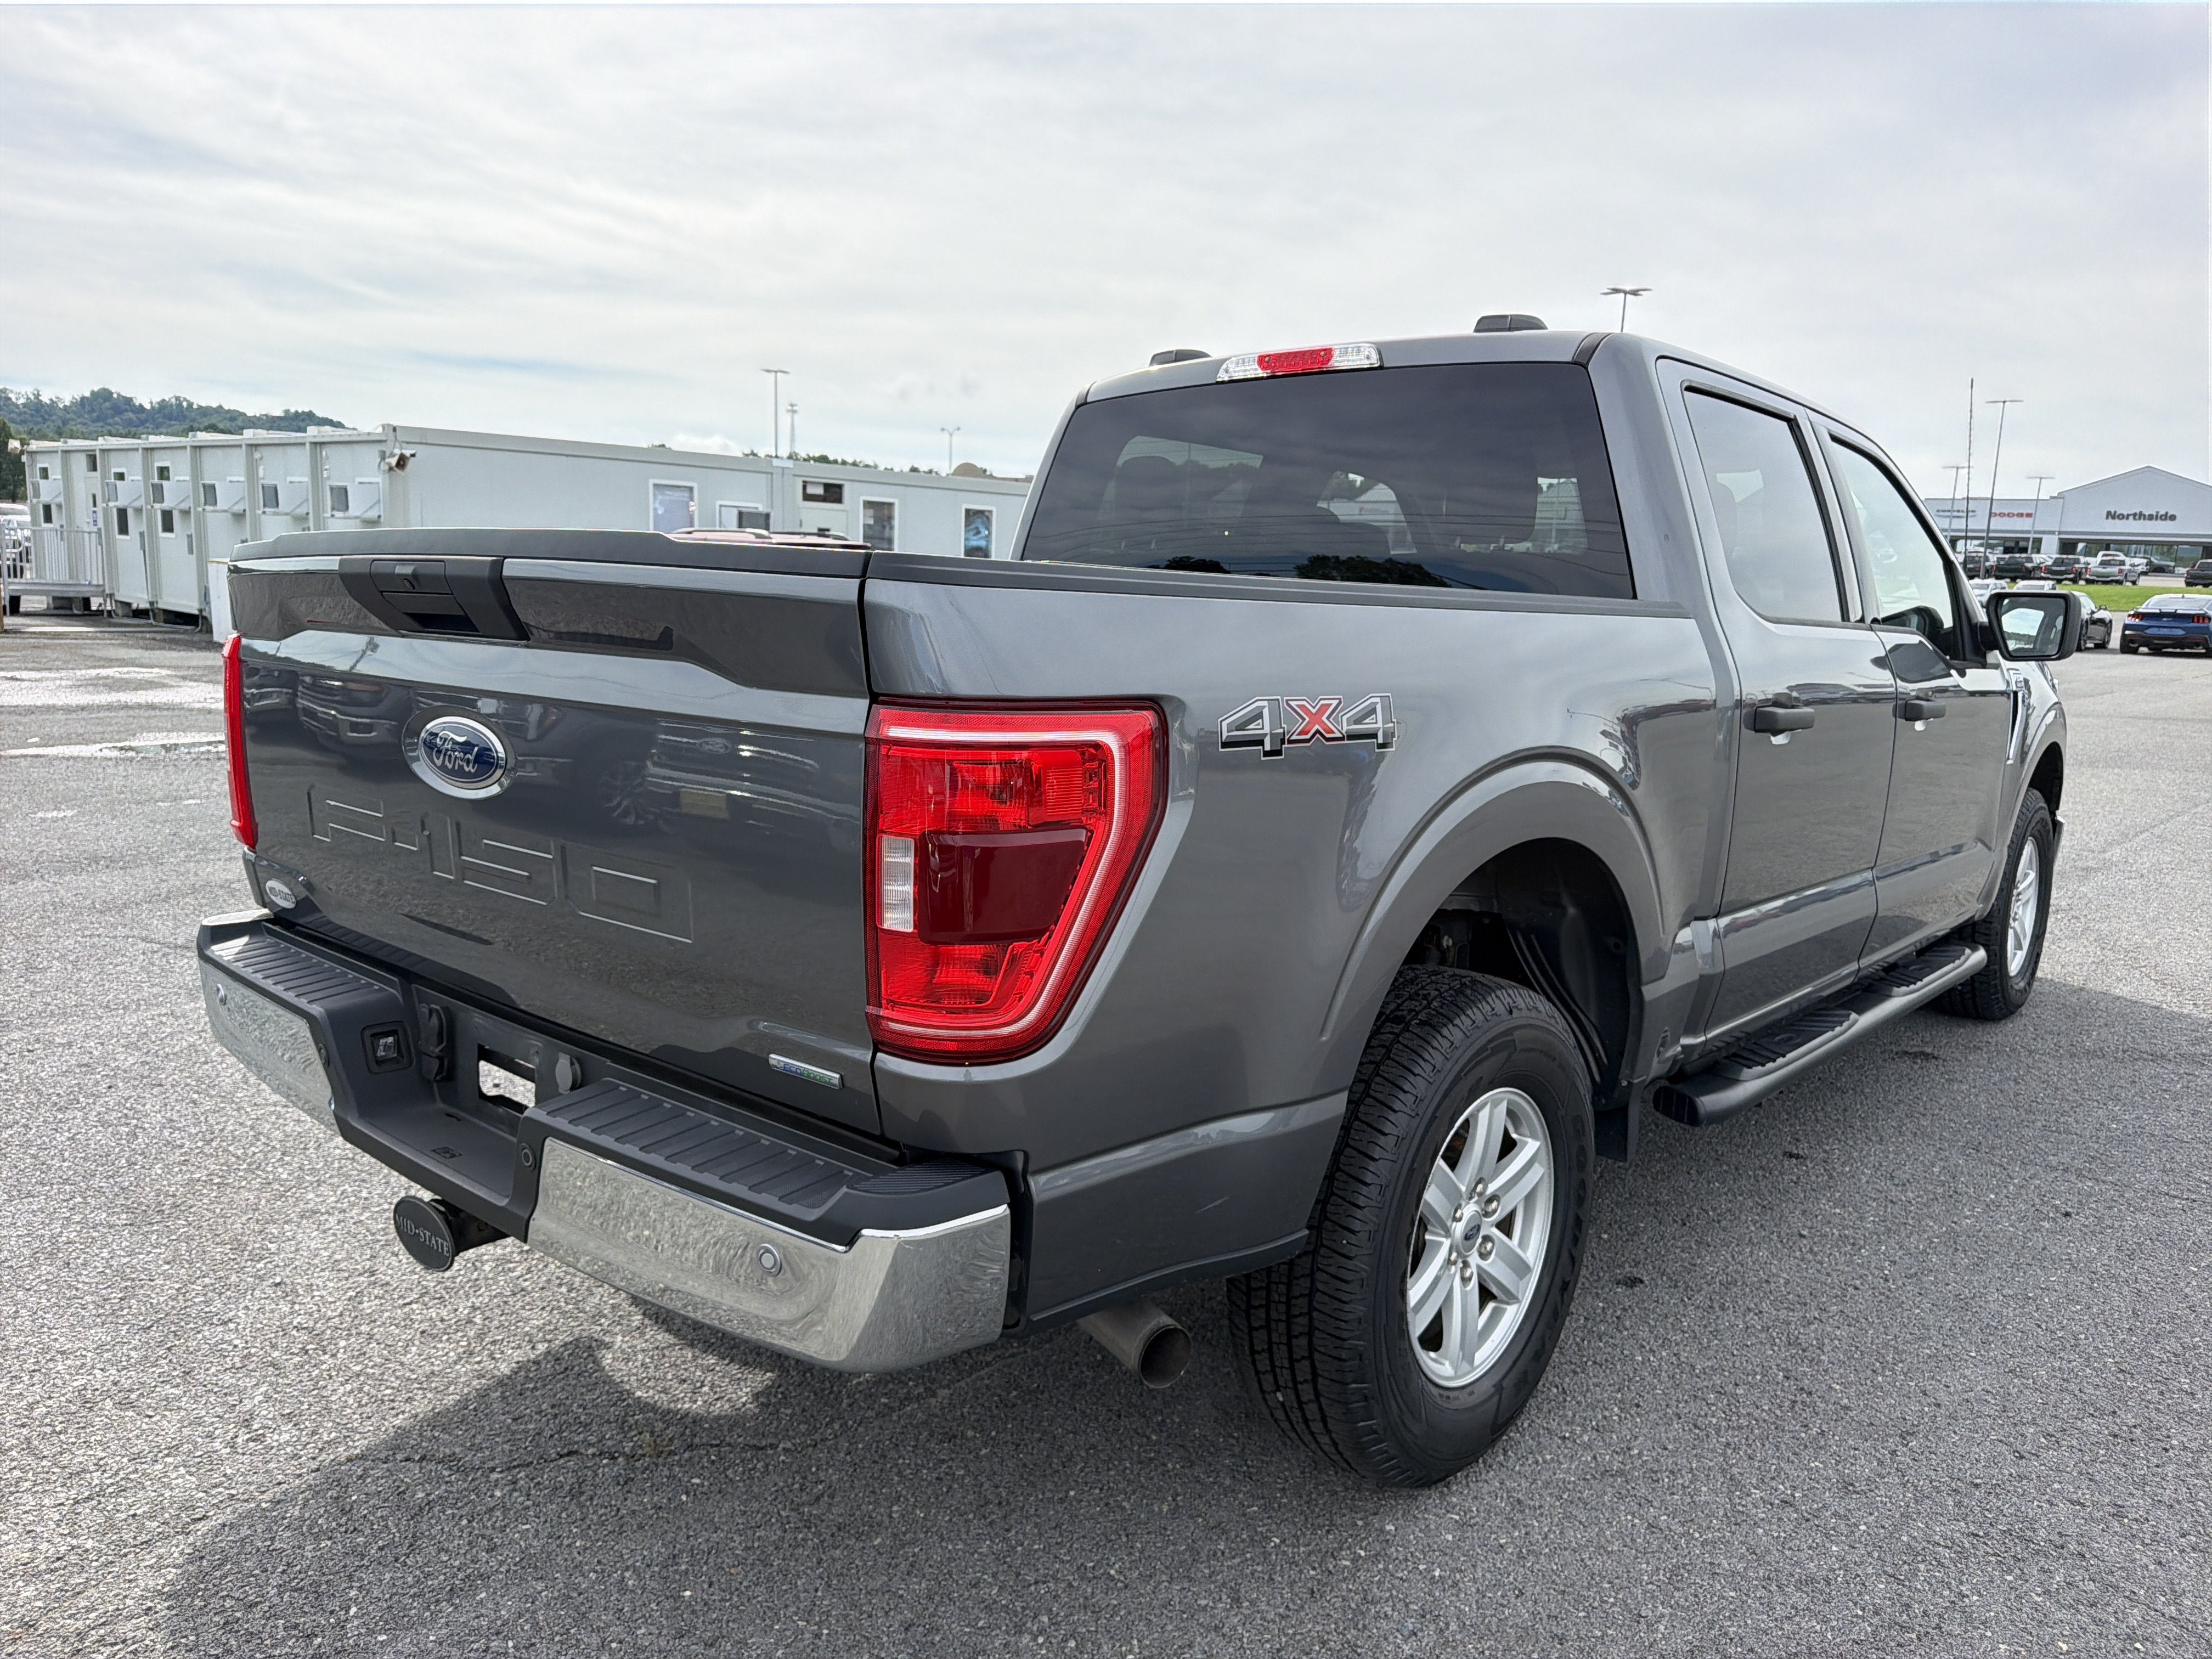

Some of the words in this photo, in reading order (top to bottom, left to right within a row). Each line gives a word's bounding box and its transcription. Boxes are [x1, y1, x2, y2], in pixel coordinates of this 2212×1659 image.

[2106, 510, 2177, 521] Northside
[433, 730, 478, 773] Ford
[307, 785, 693, 944] F-150
